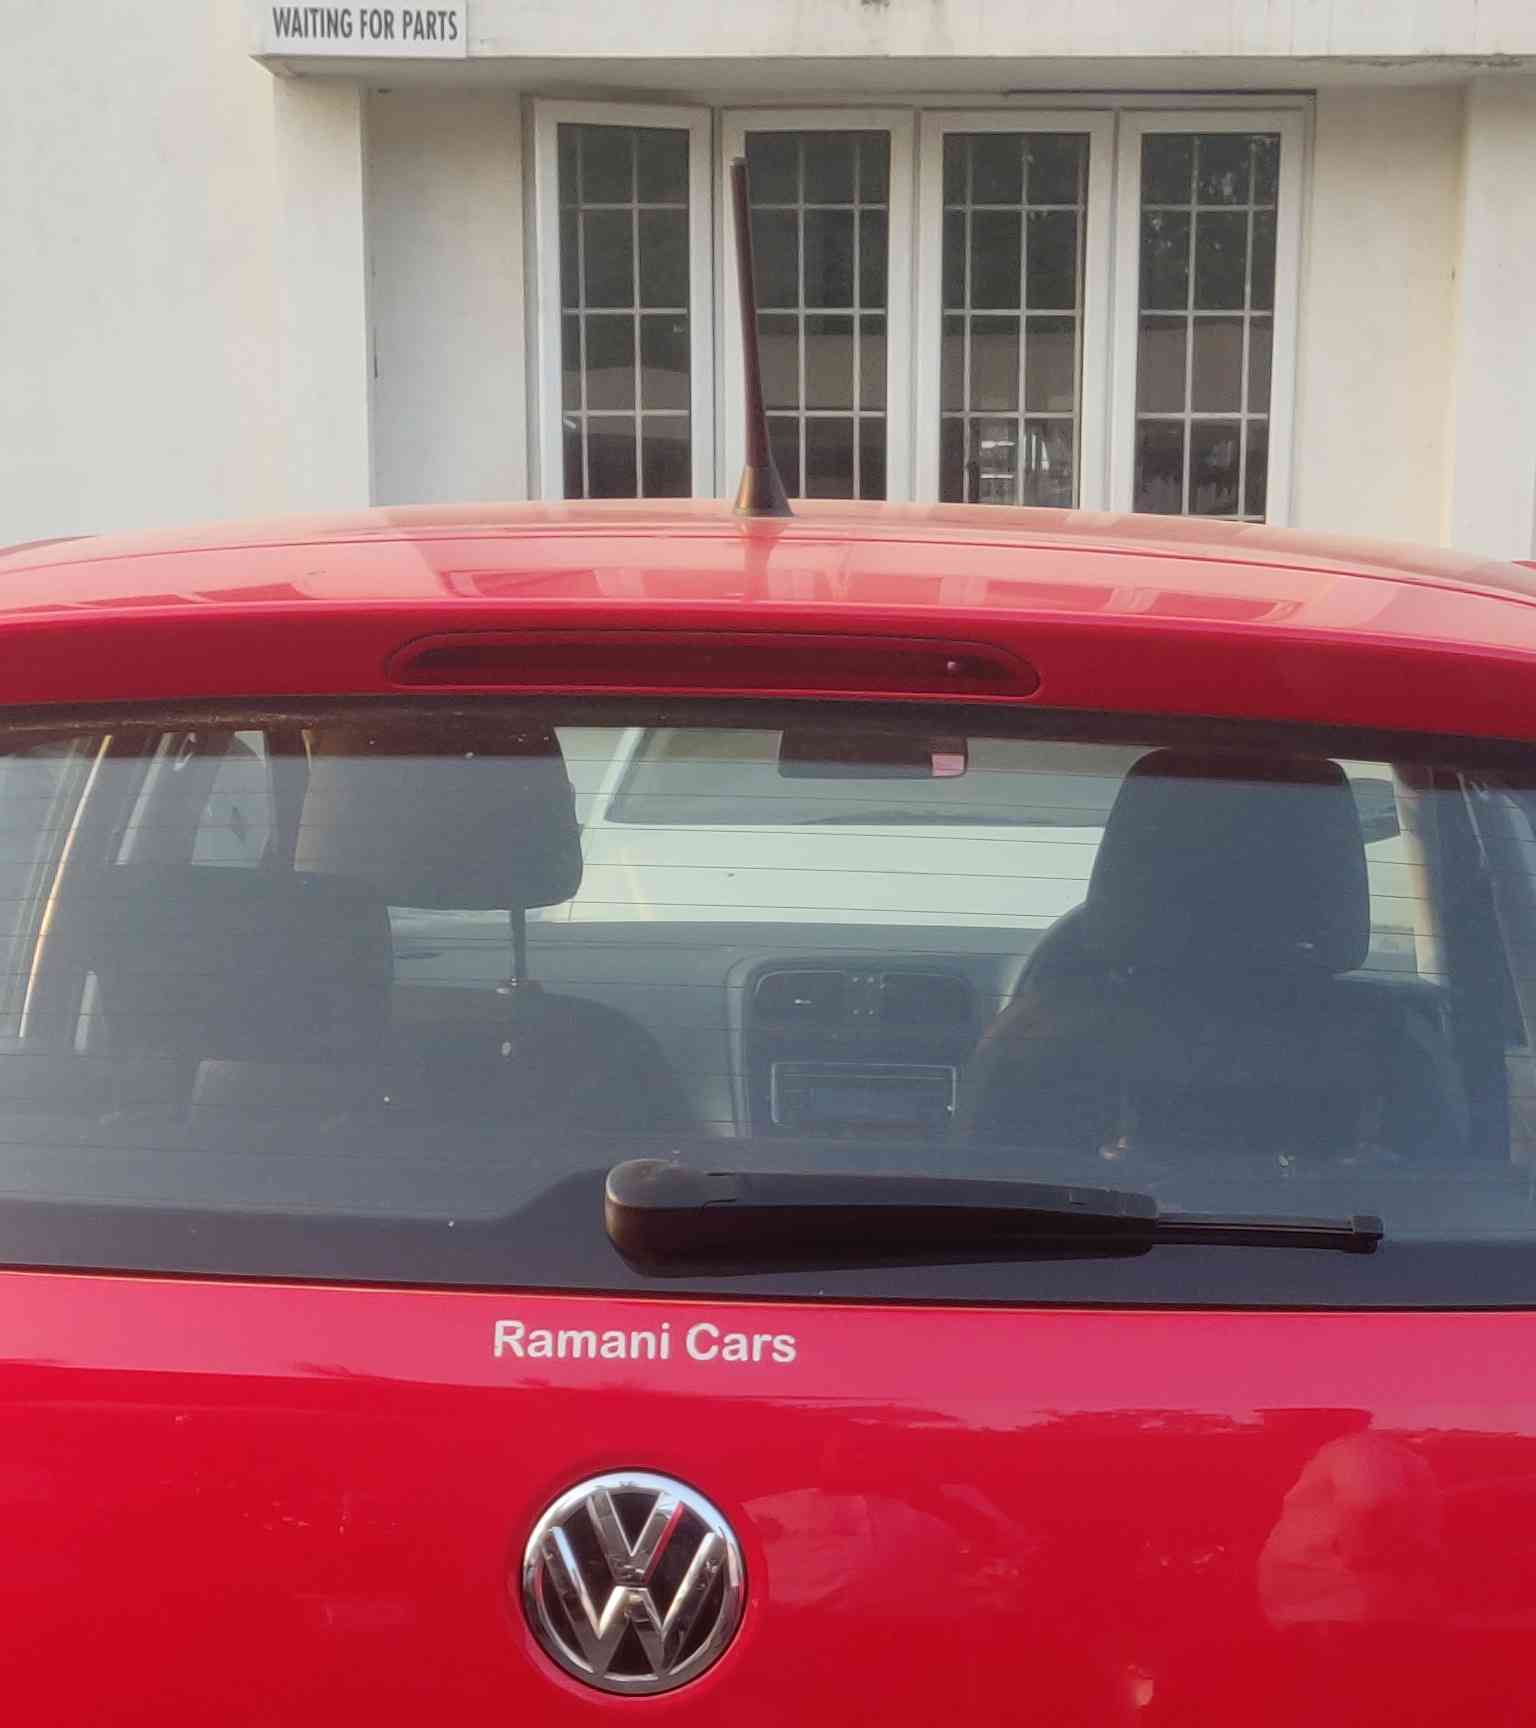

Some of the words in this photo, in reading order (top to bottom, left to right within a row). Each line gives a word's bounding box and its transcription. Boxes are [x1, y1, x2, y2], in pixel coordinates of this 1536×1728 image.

[272, 6, 352, 39] WAITING
[360, 9, 395, 39] FOR
[402, 10, 458, 40] PARTS
[494, 1319, 671, 1360] Ramani
[686, 1322, 797, 1363] Cars
